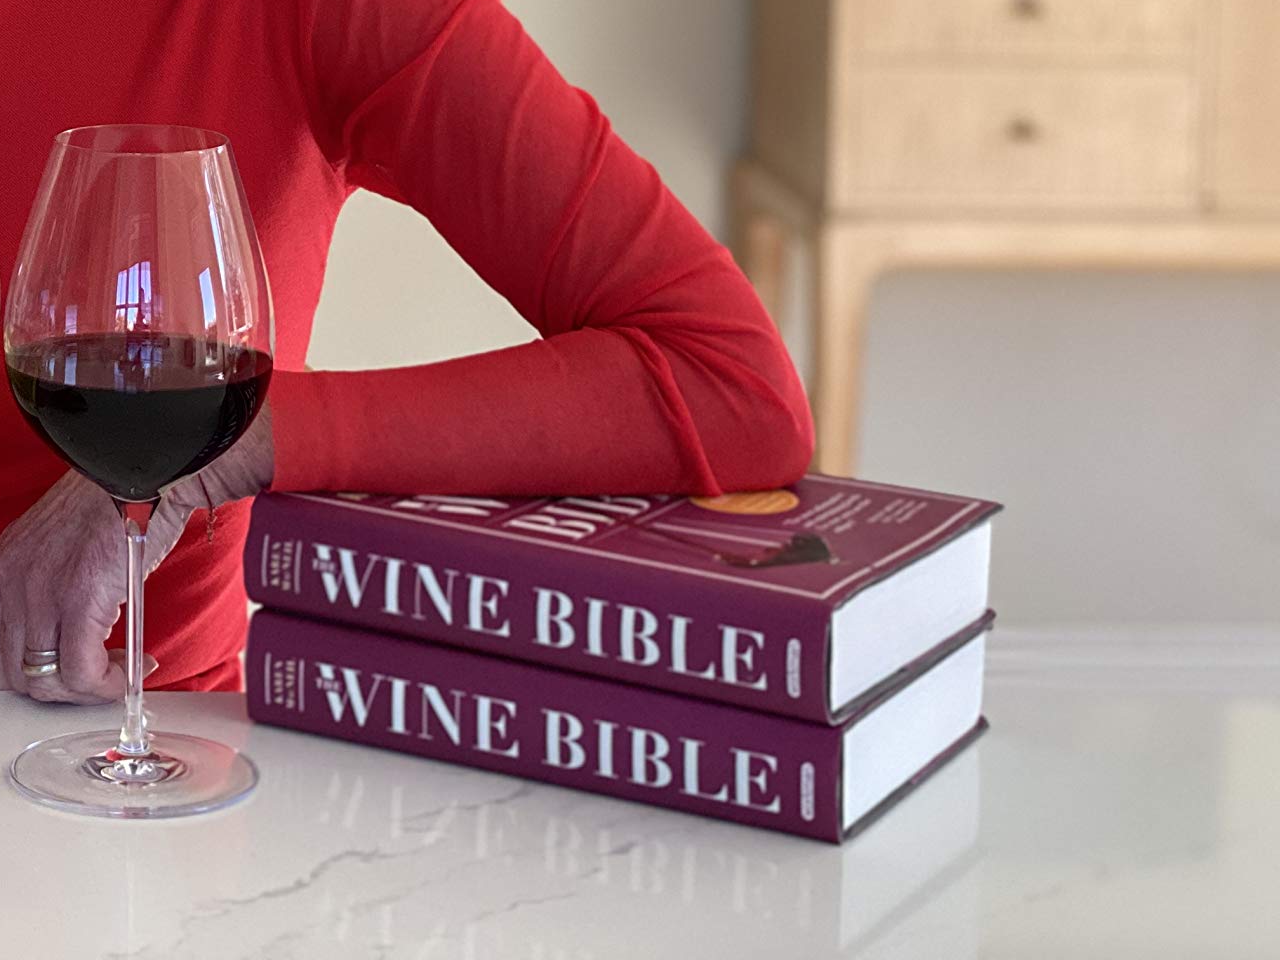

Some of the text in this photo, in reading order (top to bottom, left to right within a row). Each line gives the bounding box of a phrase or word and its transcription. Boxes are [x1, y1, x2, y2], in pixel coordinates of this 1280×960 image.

[312, 543, 511, 638] WINE
[533, 587, 768, 691] BIBLE
[315, 662, 520, 759] WINE
[540, 708, 781, 814] BIBLE
